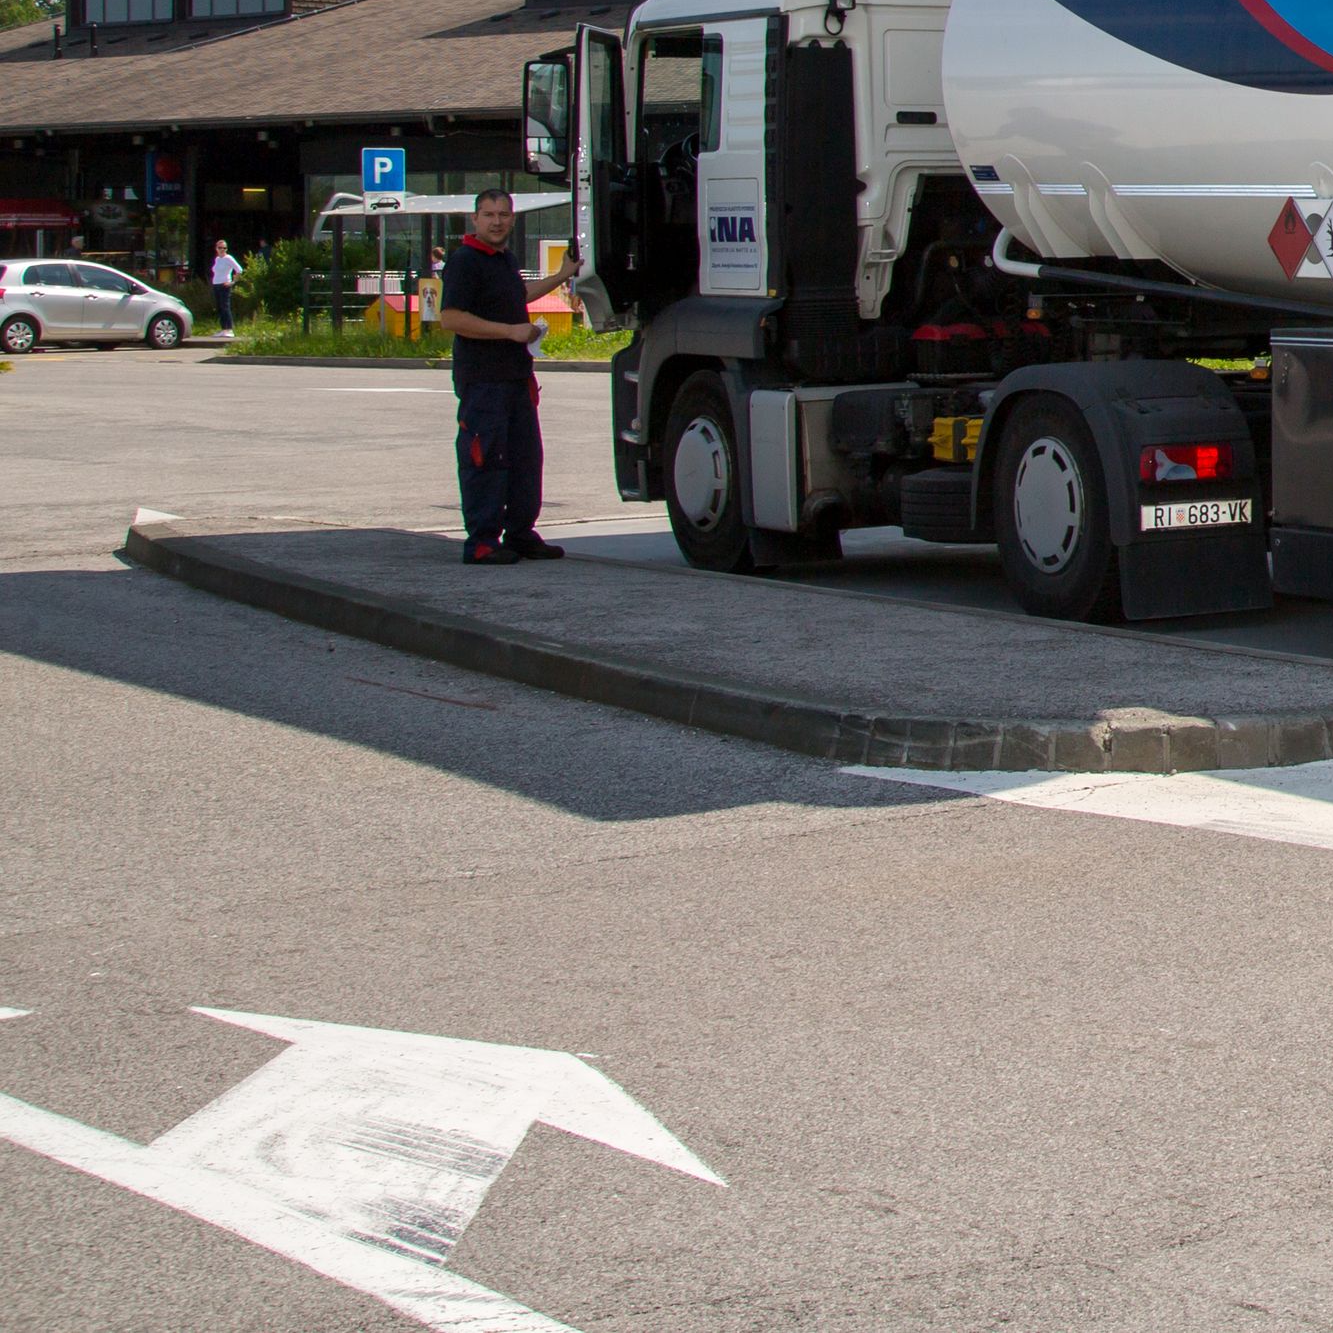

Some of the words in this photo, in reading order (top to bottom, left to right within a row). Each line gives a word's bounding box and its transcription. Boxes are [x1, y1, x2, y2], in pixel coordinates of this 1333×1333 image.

[373, 156, 393, 184] P
[710, 216, 756, 243] INA
[1154, 507, 1172, 527] RI
[1188, 502, 1248, 525] 683-VK
